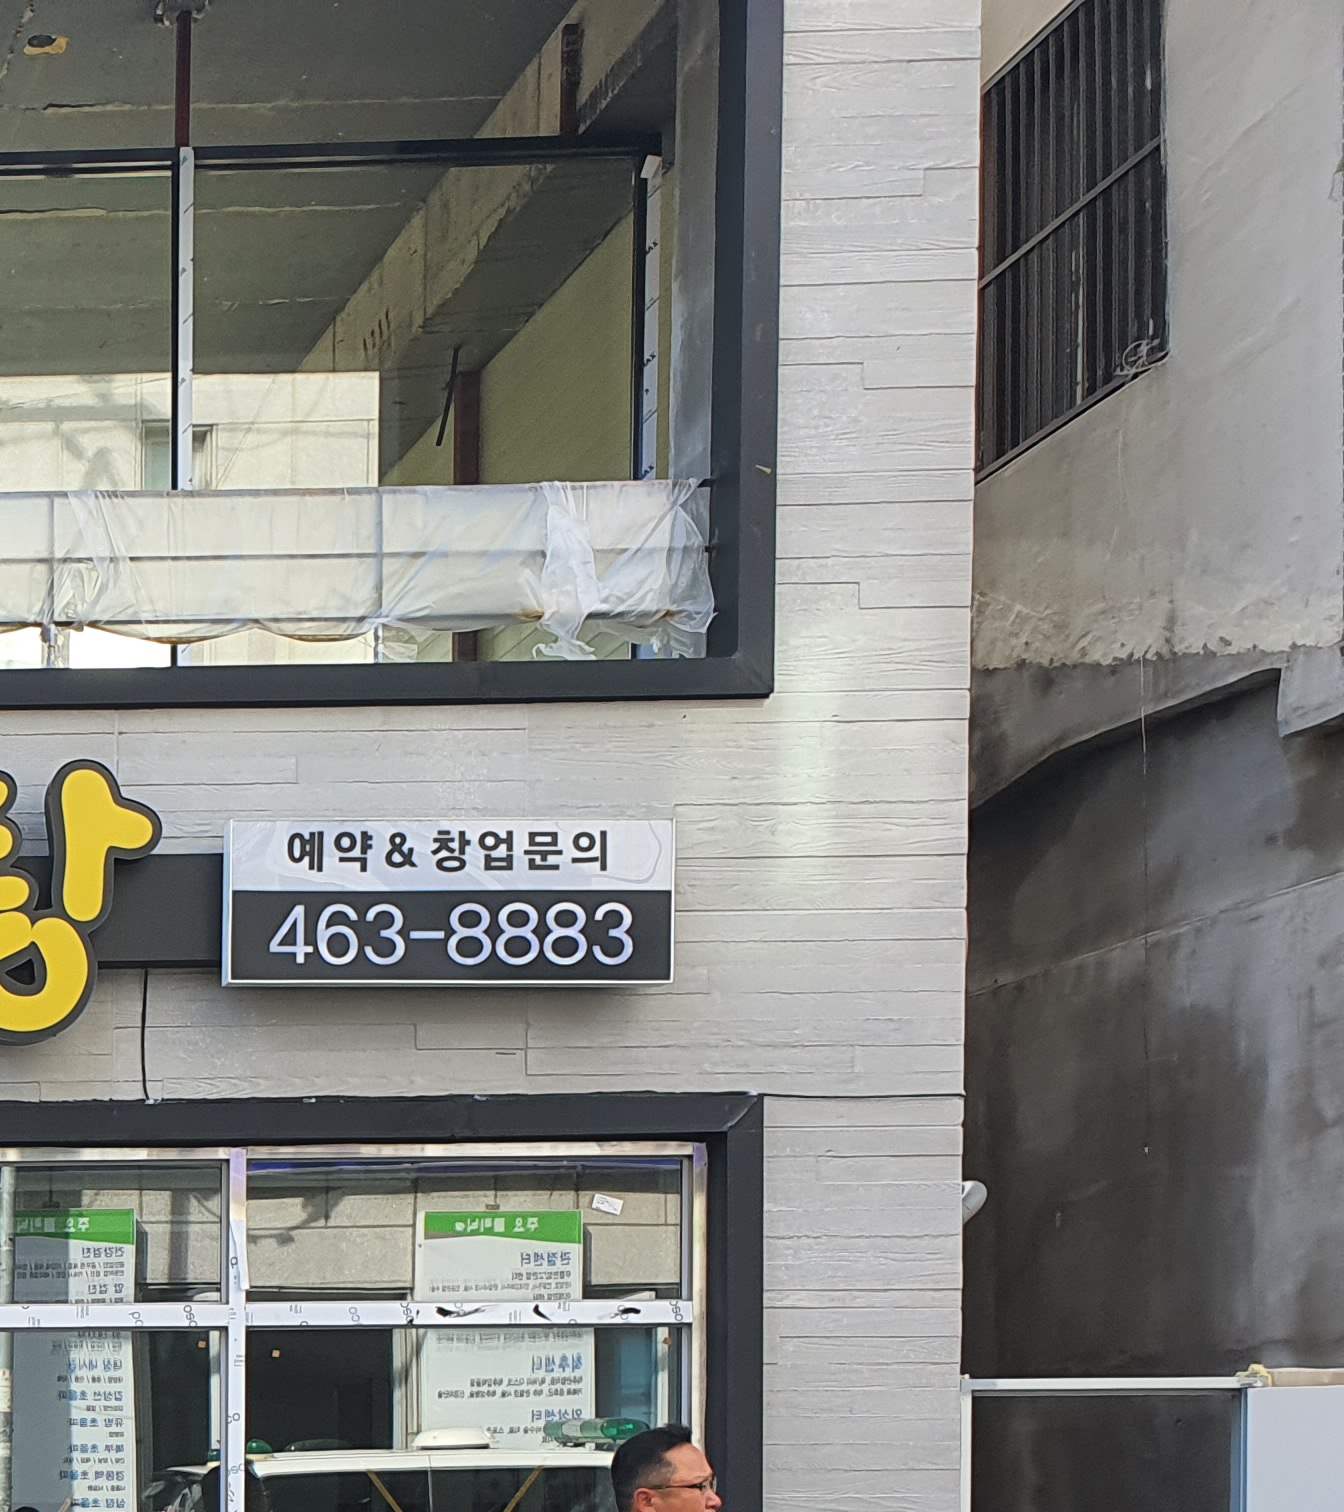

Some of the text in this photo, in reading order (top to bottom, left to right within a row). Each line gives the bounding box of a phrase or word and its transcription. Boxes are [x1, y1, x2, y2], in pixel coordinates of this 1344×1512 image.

[286, 829, 610, 874] 예약 & 창업문의
[267, 901, 635, 967] 463-8883
